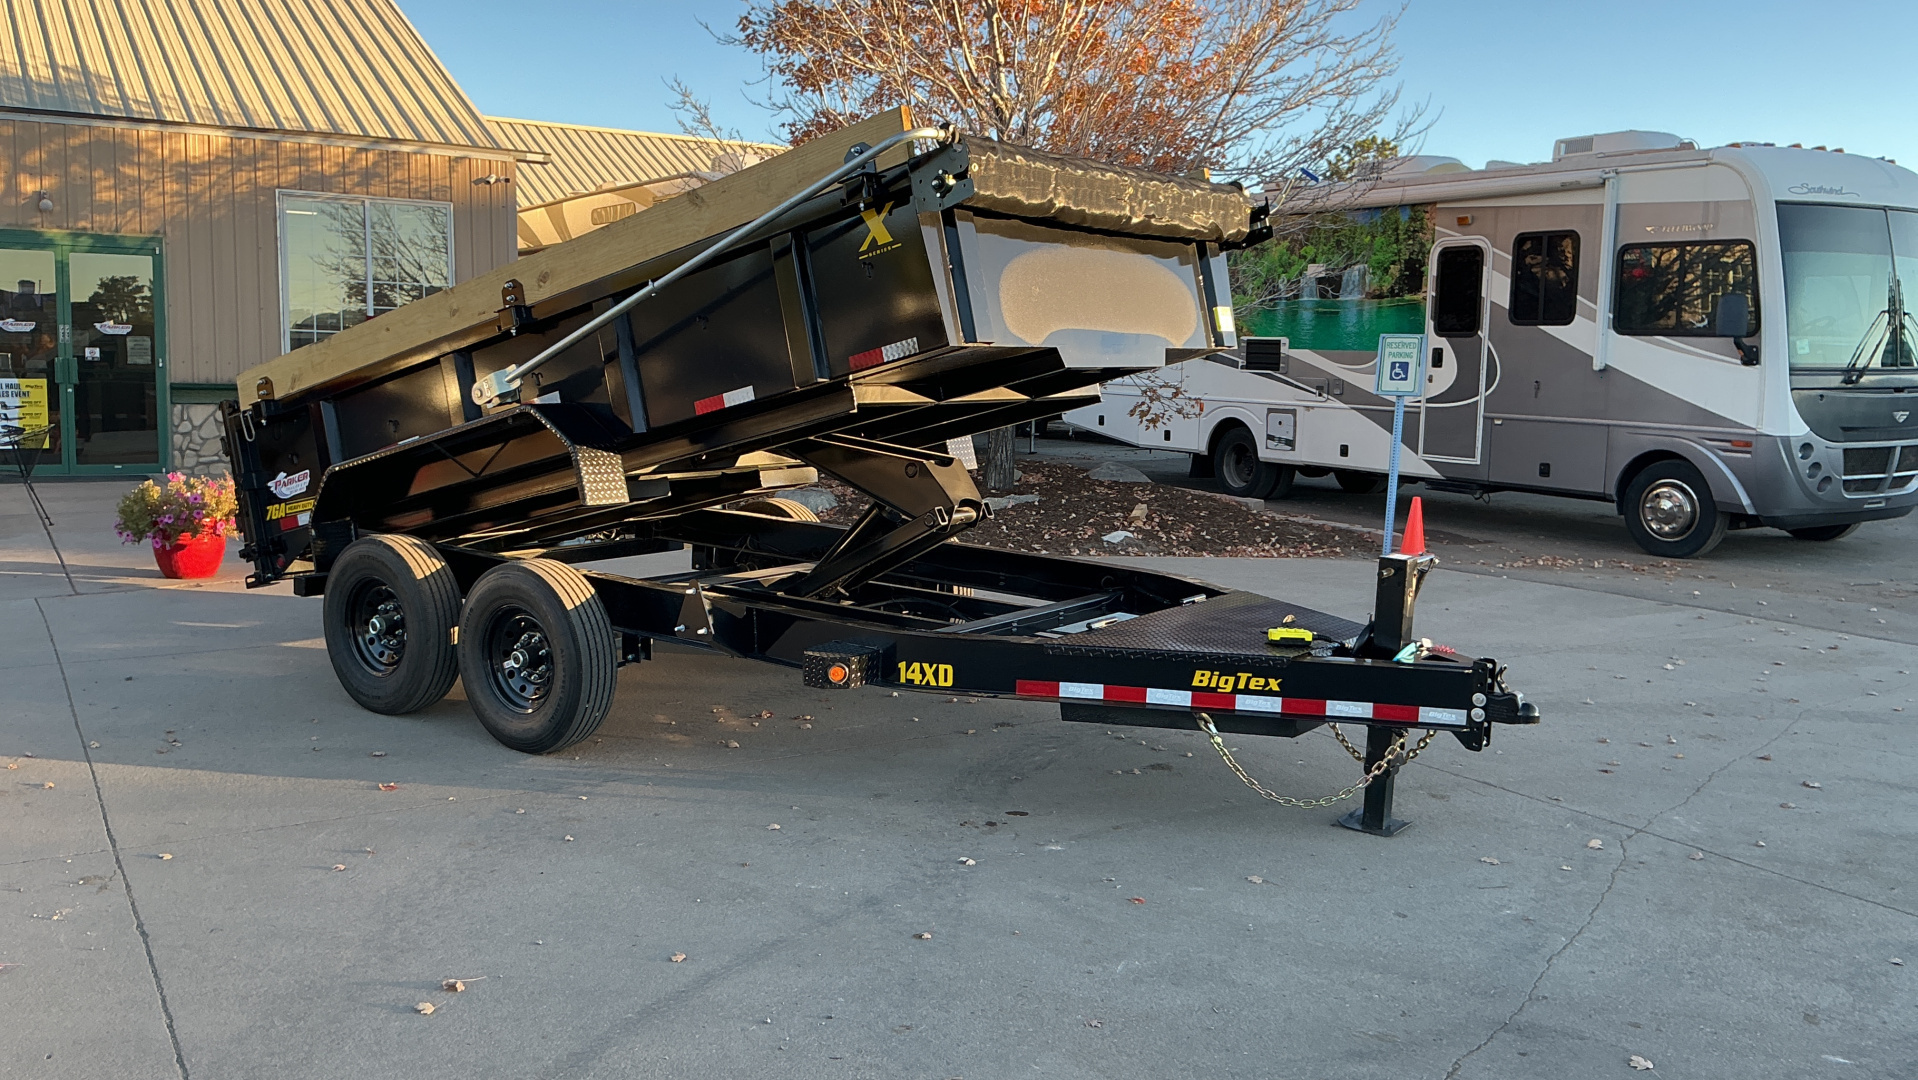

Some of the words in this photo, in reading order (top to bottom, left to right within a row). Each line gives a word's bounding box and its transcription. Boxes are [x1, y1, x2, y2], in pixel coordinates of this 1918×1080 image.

[859, 201, 895, 252] X
[1386, 341, 1417, 349] RESERVED
[1388, 351, 1414, 359] PARKING
[274, 472, 309, 490] PARKER
[266, 502, 286, 521] 7GA
[288, 503, 301, 511] HEAVY
[898, 661, 953, 687] 14XD
[1191, 670, 1283, 692] BigTex
[1068, 686, 1094, 694] BigTex
[1335, 704, 1362, 713] BigTex
[1428, 711, 1456, 720] BigTex
